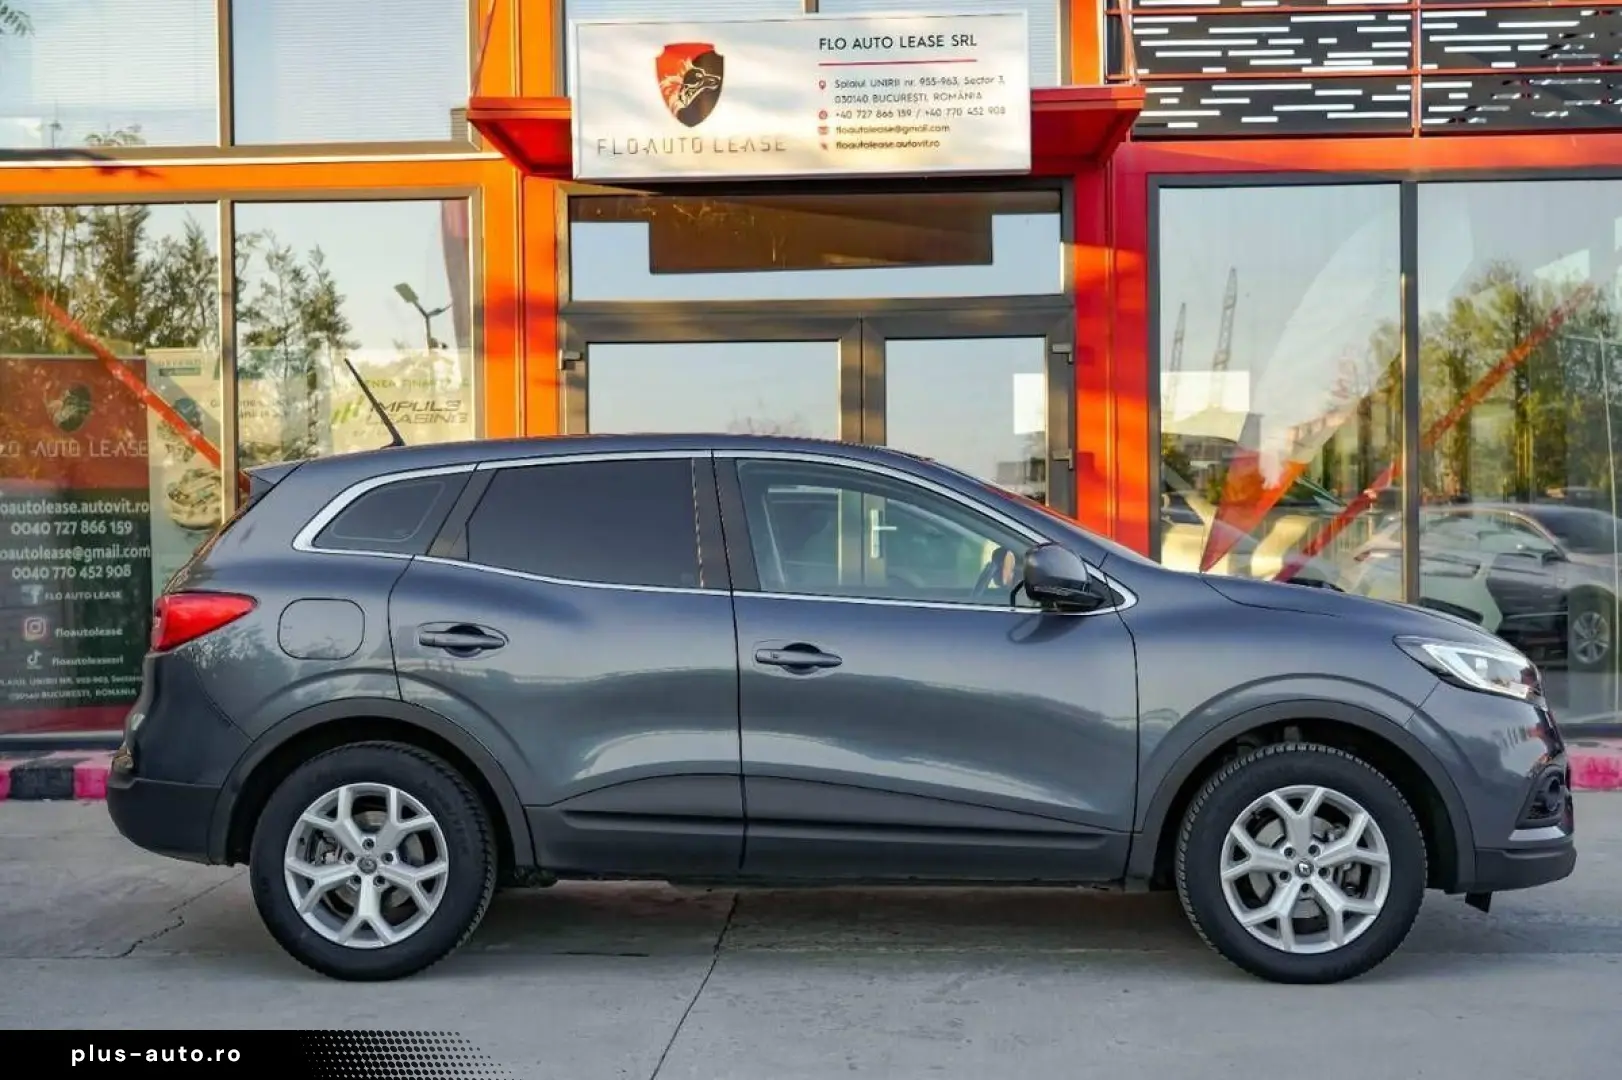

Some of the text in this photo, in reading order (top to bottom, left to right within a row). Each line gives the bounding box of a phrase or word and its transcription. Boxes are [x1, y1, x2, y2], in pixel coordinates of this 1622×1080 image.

[819, 33, 977, 50] FLO AUTO LEASE SRL
[857, 110, 872, 119] 727
[898, 108, 912, 118] 159
[945, 107, 963, 117] 770
[967, 106, 984, 116] 452
[597, 137, 787, 155] FLO AUTO LEASE
[31, 440, 81, 458] AUTO
[89, 440, 149, 458] LEASE
[10, 520, 133, 535] 0040 727 866 159
[12, 564, 132, 580] 0040 770 452 908
[64, 591, 93, 600] AUTO
